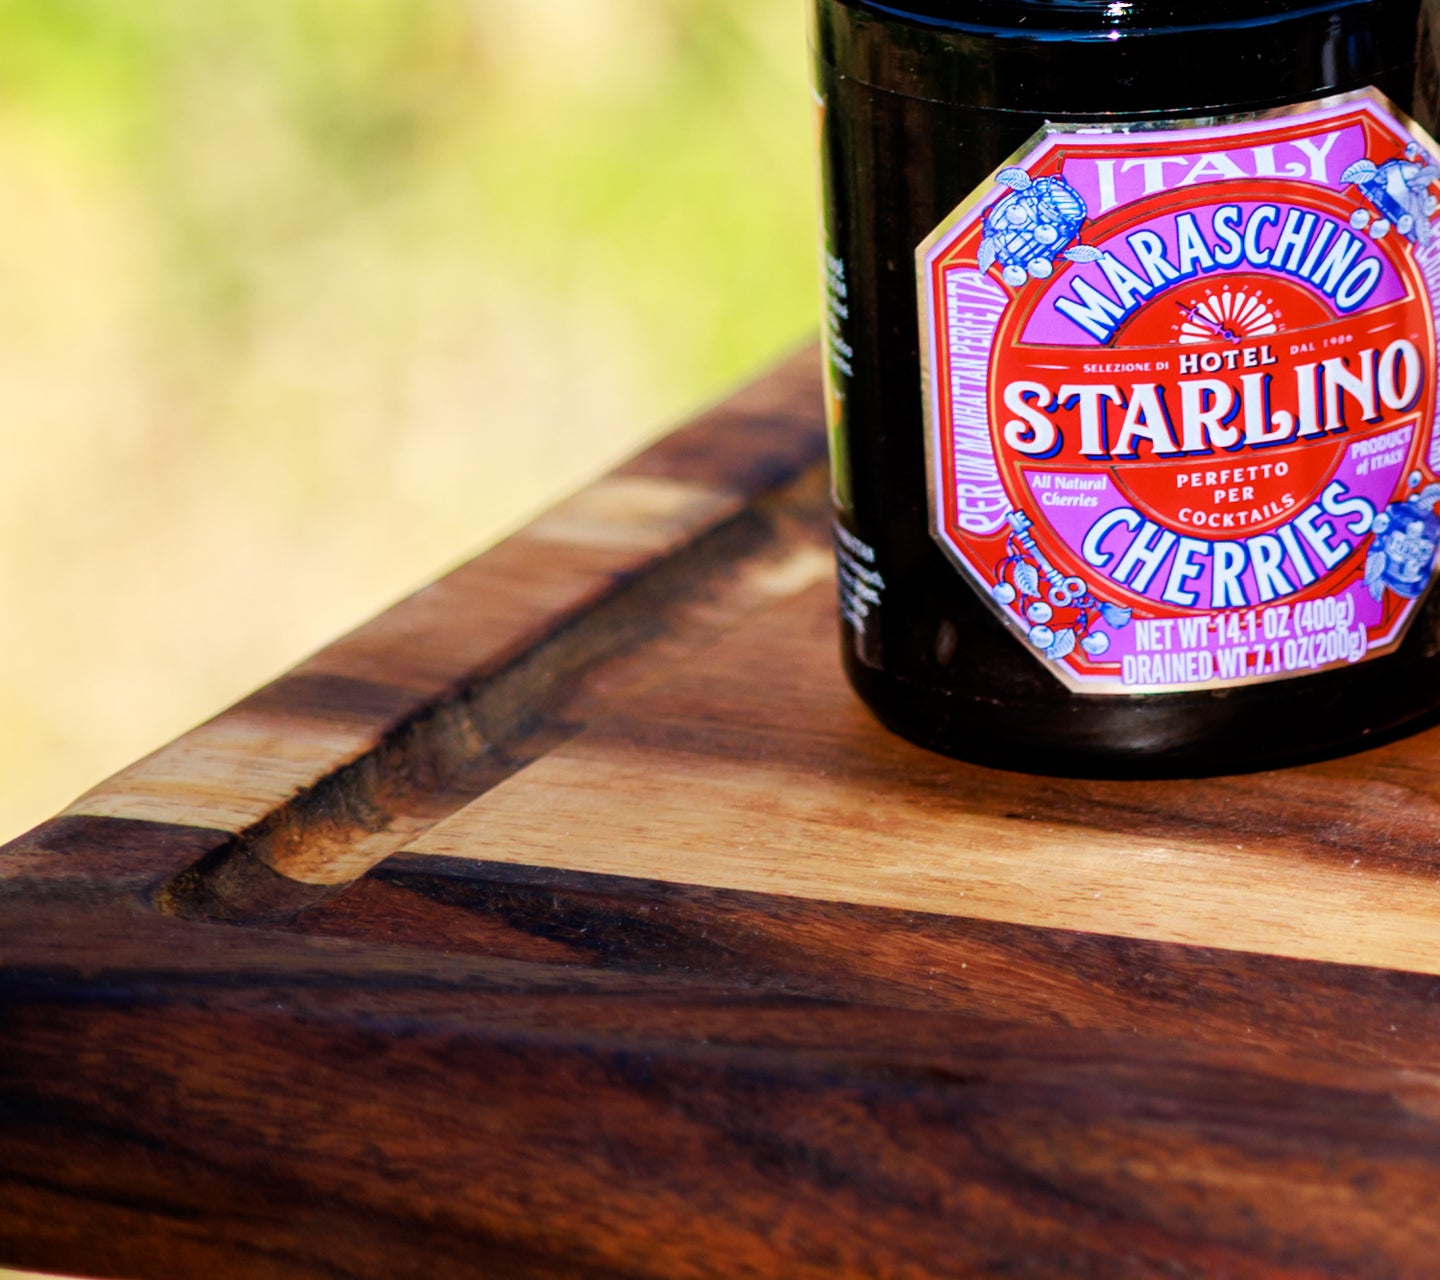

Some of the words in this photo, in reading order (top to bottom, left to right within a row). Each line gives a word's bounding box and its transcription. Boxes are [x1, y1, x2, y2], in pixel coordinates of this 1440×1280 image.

[1093, 131, 1341, 212] ITALY
[1055, 204, 1383, 345] MARASCHINO
[944, 271, 1010, 356] PERFETTA
[1083, 363, 1151, 373] SELEZIONE
[1155, 361, 1169, 370] DI
[1179, 345, 1276, 374] HOTEL
[1290, 342, 1315, 355] DAL
[951, 354, 994, 454] MANHATTAN
[1003, 338, 1420, 458] STARLINO
[1351, 425, 1412, 460] PRODUCT
[954, 453, 998, 482] UN
[1032, 474, 1052, 488] All
[1054, 476, 1107, 490] Natural
[1176, 462, 1289, 488] PERFETTO
[956, 484, 1011, 534] PER
[1041, 491, 1098, 508] Cherries
[1178, 492, 1296, 528] COCKTAILS
[1214, 486, 1255, 504] PER
[1080, 480, 1375, 610] CHERRIES
[1135, 618, 1172, 652] NET
[1216, 610, 1257, 646] 14.1
[1262, 604, 1290, 641] OZ
[1294, 592, 1355, 639] (400g)
[1123, 650, 1213, 685] DRAINED
[1256, 642, 1280, 675] 7.1
